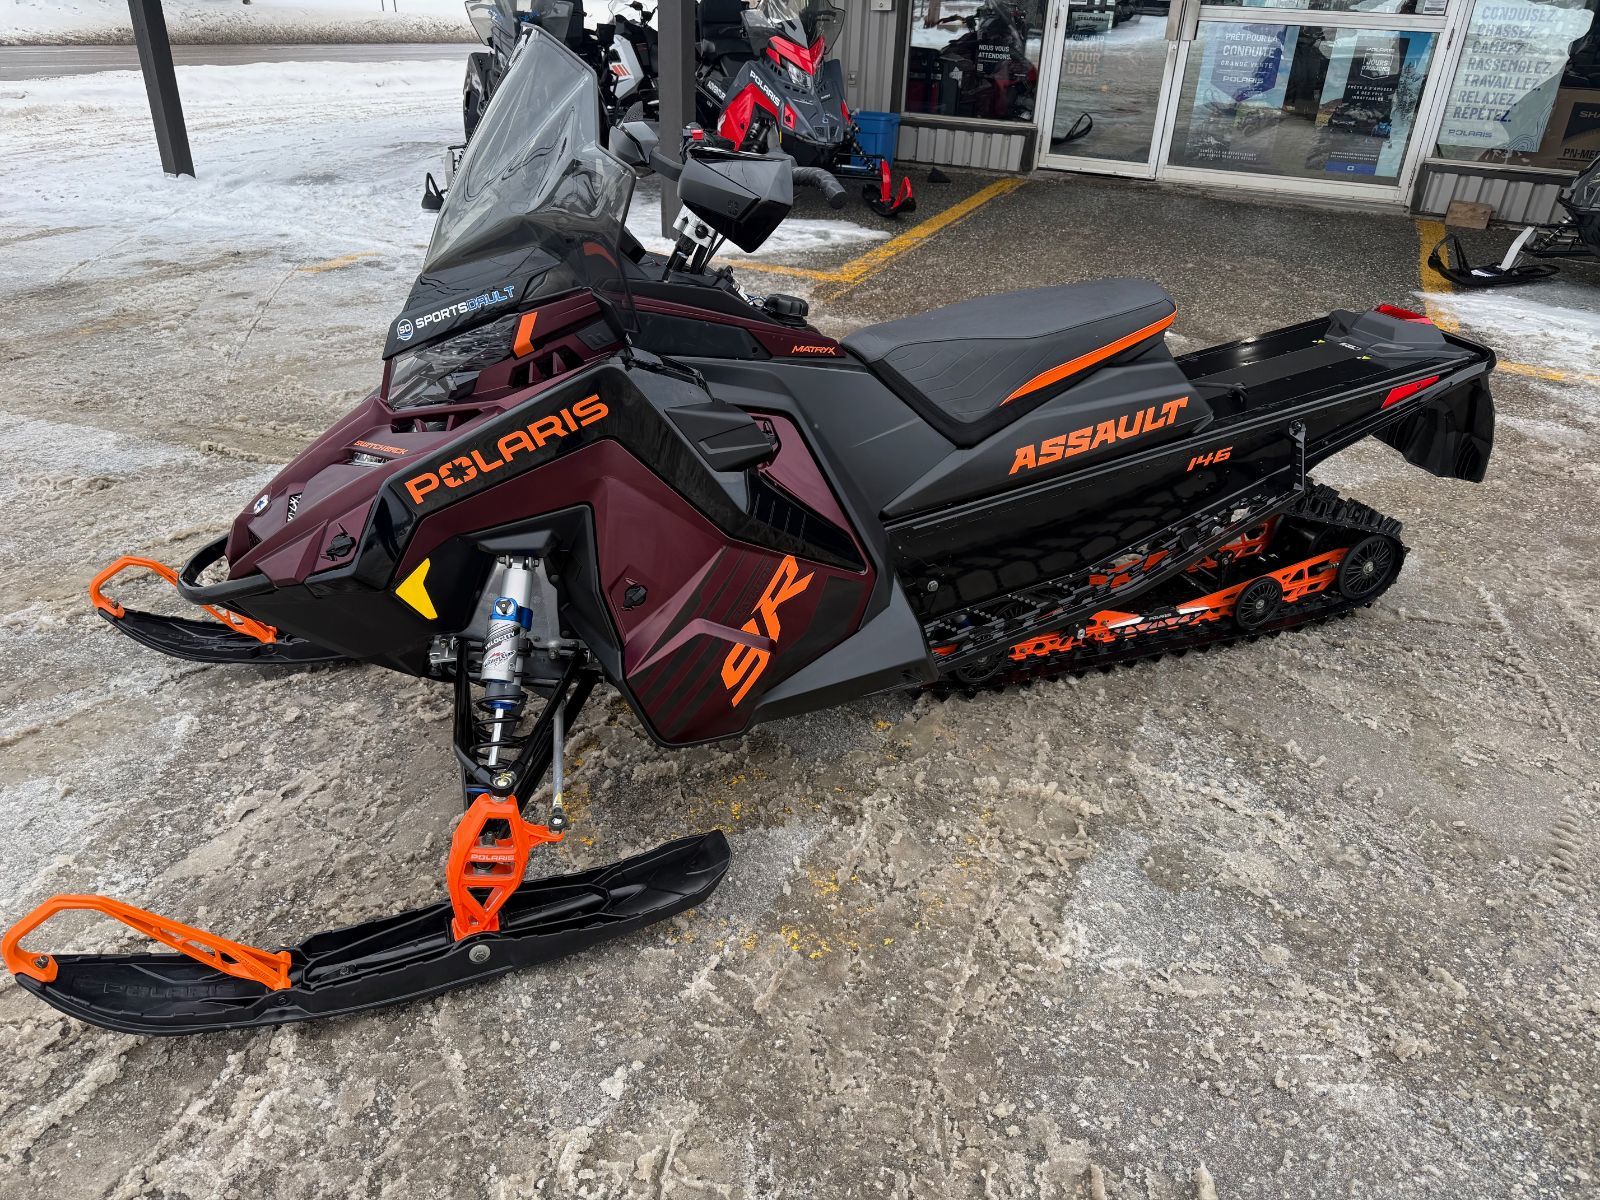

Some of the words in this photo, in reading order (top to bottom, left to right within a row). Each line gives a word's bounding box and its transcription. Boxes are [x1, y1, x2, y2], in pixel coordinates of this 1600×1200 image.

[1246, 34, 1266, 42] POUR
[1477, 23, 1537, 39] CHASSEZ.
[1069, 51, 1101, 63] YOUR
[1222, 45, 1277, 58] CONDUITE
[1067, 62, 1100, 75] DEAL
[1222, 75, 1264, 84] POLARIS
[750, 70, 781, 107] POLARIS
[1453, 104, 1512, 122] RÉPÉTEZ.
[1447, 129, 1493, 138] POLARIS
[791, 344, 836, 356] MATRYX
[1008, 397, 1189, 475] ASSAULT
[353, 439, 409, 455] SWITCHBACK
[404, 394, 609, 505] POLARIS
[1186, 445, 1234, 473] 146
[484, 631, 515, 651] VELOCITY
[470, 853, 515, 861] POLARIS
[103, 982, 236, 998] POLARIS
